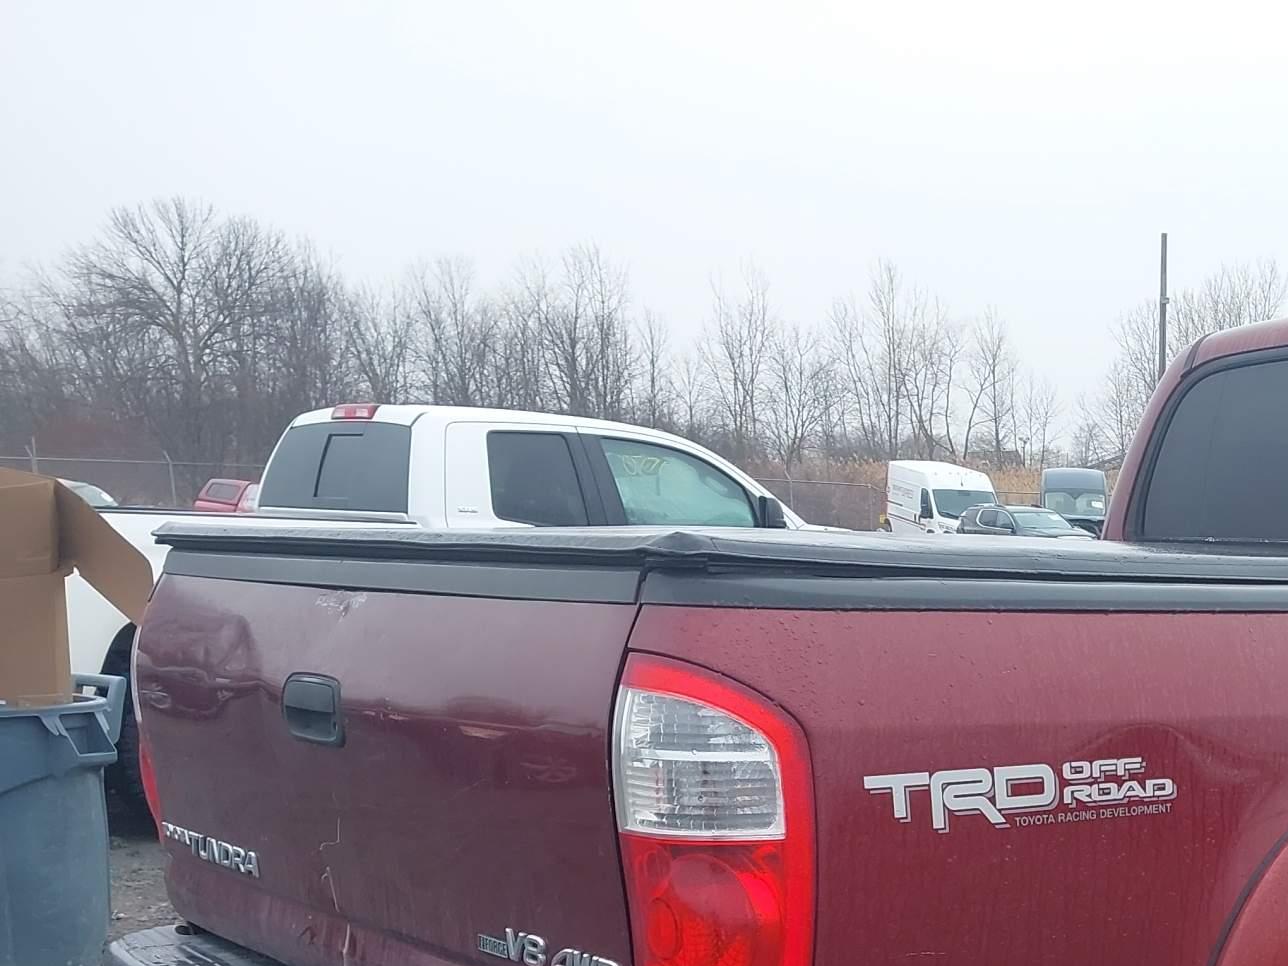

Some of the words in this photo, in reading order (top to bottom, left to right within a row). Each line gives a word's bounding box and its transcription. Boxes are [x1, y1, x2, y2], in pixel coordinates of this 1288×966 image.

[1062, 757, 1147, 783] OFF
[863, 764, 1059, 834] TRD
[1062, 778, 1177, 808] ROAD
[1014, 813, 1056, 828] TOYOTA
[1057, 809, 1097, 825] RACING
[1099, 803, 1173, 820] DEVELOPMENT
[188, 831, 259, 878] TUNDRA
